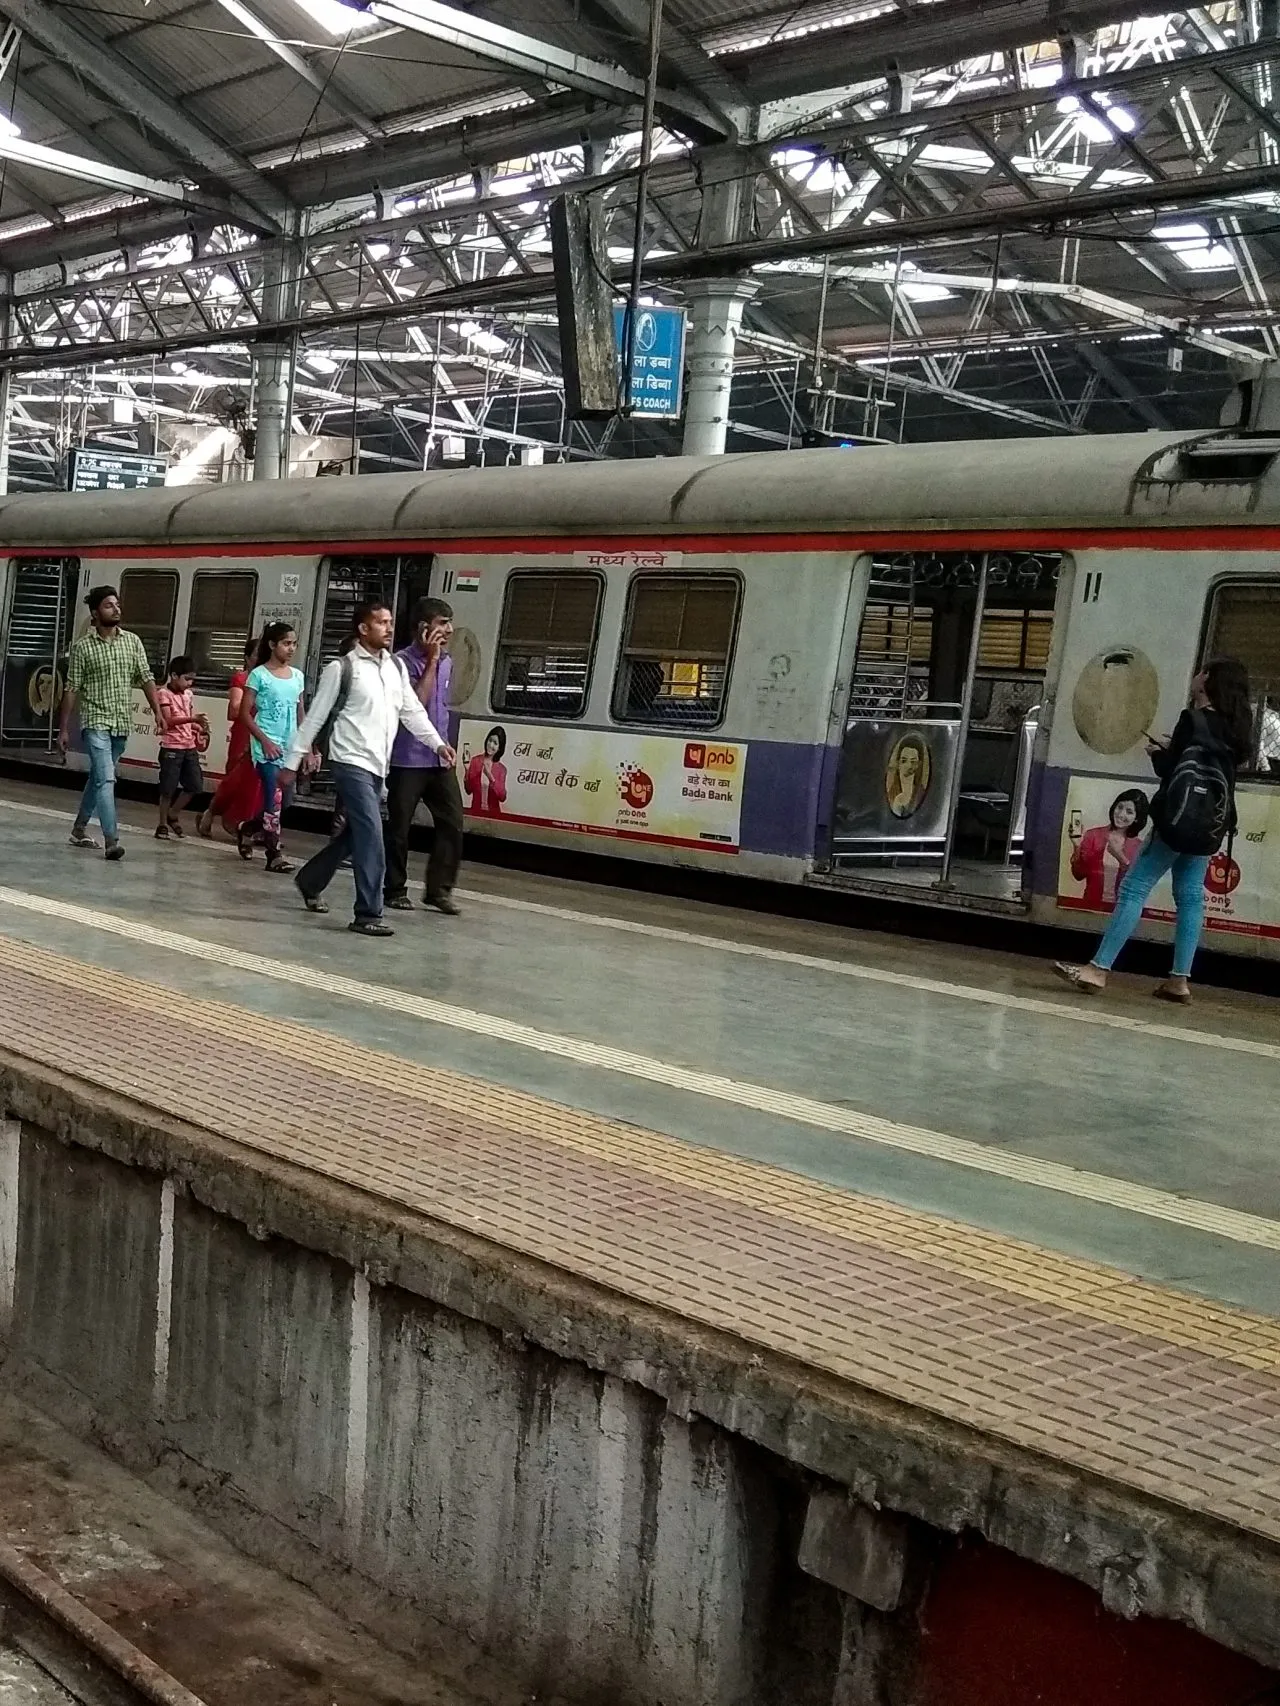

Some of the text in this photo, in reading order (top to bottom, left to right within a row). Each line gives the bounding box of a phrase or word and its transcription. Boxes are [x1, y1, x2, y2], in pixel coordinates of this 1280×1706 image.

[643, 396, 671, 409] COACH
[587, 551, 668, 566] मध्य रेल्वे
[513, 742, 533, 757] हम
[706, 749, 735, 768] pnb
[517, 769, 550, 786] हमारा
[682, 787, 734, 802] Bada Bank
[631, 810, 647, 819] one
